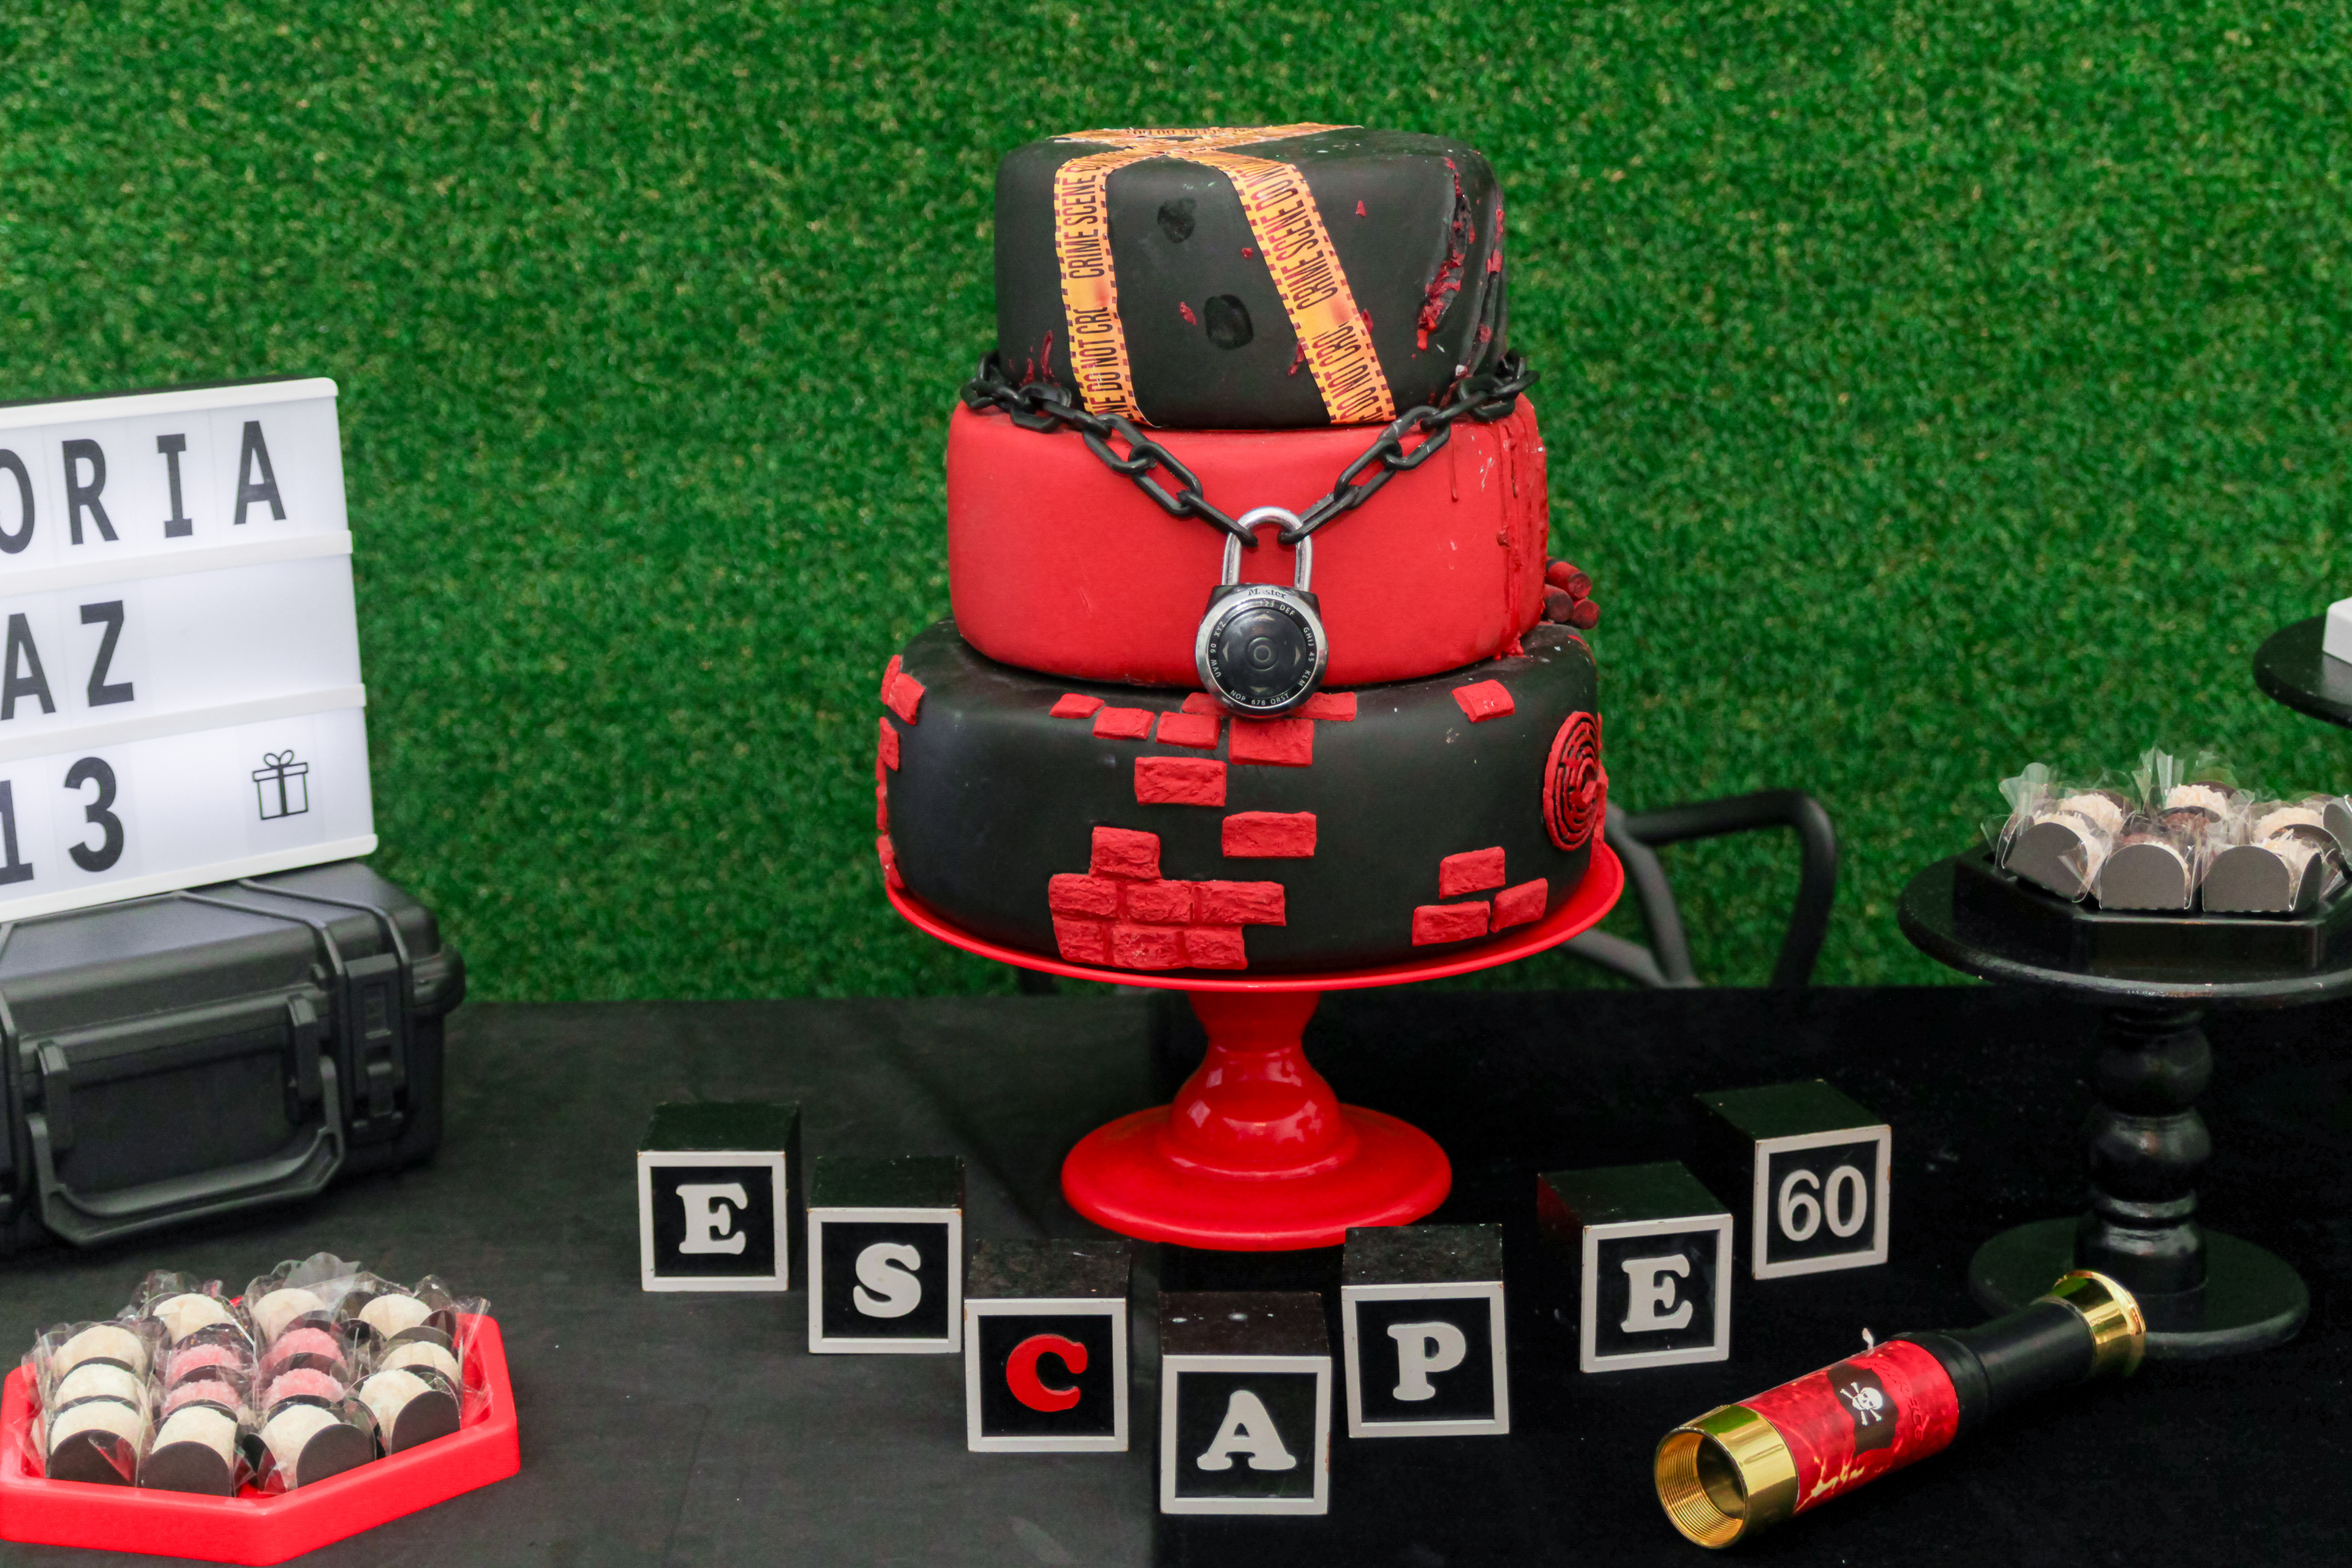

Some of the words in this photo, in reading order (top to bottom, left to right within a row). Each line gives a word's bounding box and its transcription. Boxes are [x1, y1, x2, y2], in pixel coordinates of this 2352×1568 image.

[1061, 175, 1099, 226] SCENE
[1250, 179, 1298, 212] DO
[1259, 199, 1319, 262] SCENE
[1063, 228, 1105, 279] CRIME
[1280, 249, 1338, 310] CRIME
[1077, 339, 1119, 369] NOT
[1083, 371, 1123, 393] DO
[1323, 356, 1373, 400] NOT
[1336, 386, 1380, 420] DO
[1279, 604, 1295, 616] DEF
[1213, 620, 1226, 638] XYZ
[1303, 627, 1314, 646] GHIJ
[1, 600, 134, 721] AZ
[1210, 659, 1222, 678] UVW
[1298, 669, 1311, 688] KLM
[1229, 690, 1246, 702] NOP
[1270, 692, 1290, 705] QRST
[1778, 1165, 1868, 1242] 60
[676, 1182, 748, 1255] E
[853, 1242, 922, 1318] S
[1006, 1333, 1088, 1412] C
[1197, 1390, 1297, 1471] A
[1387, 1322, 1466, 1401] P
[1620, 1253, 1694, 1333] E
